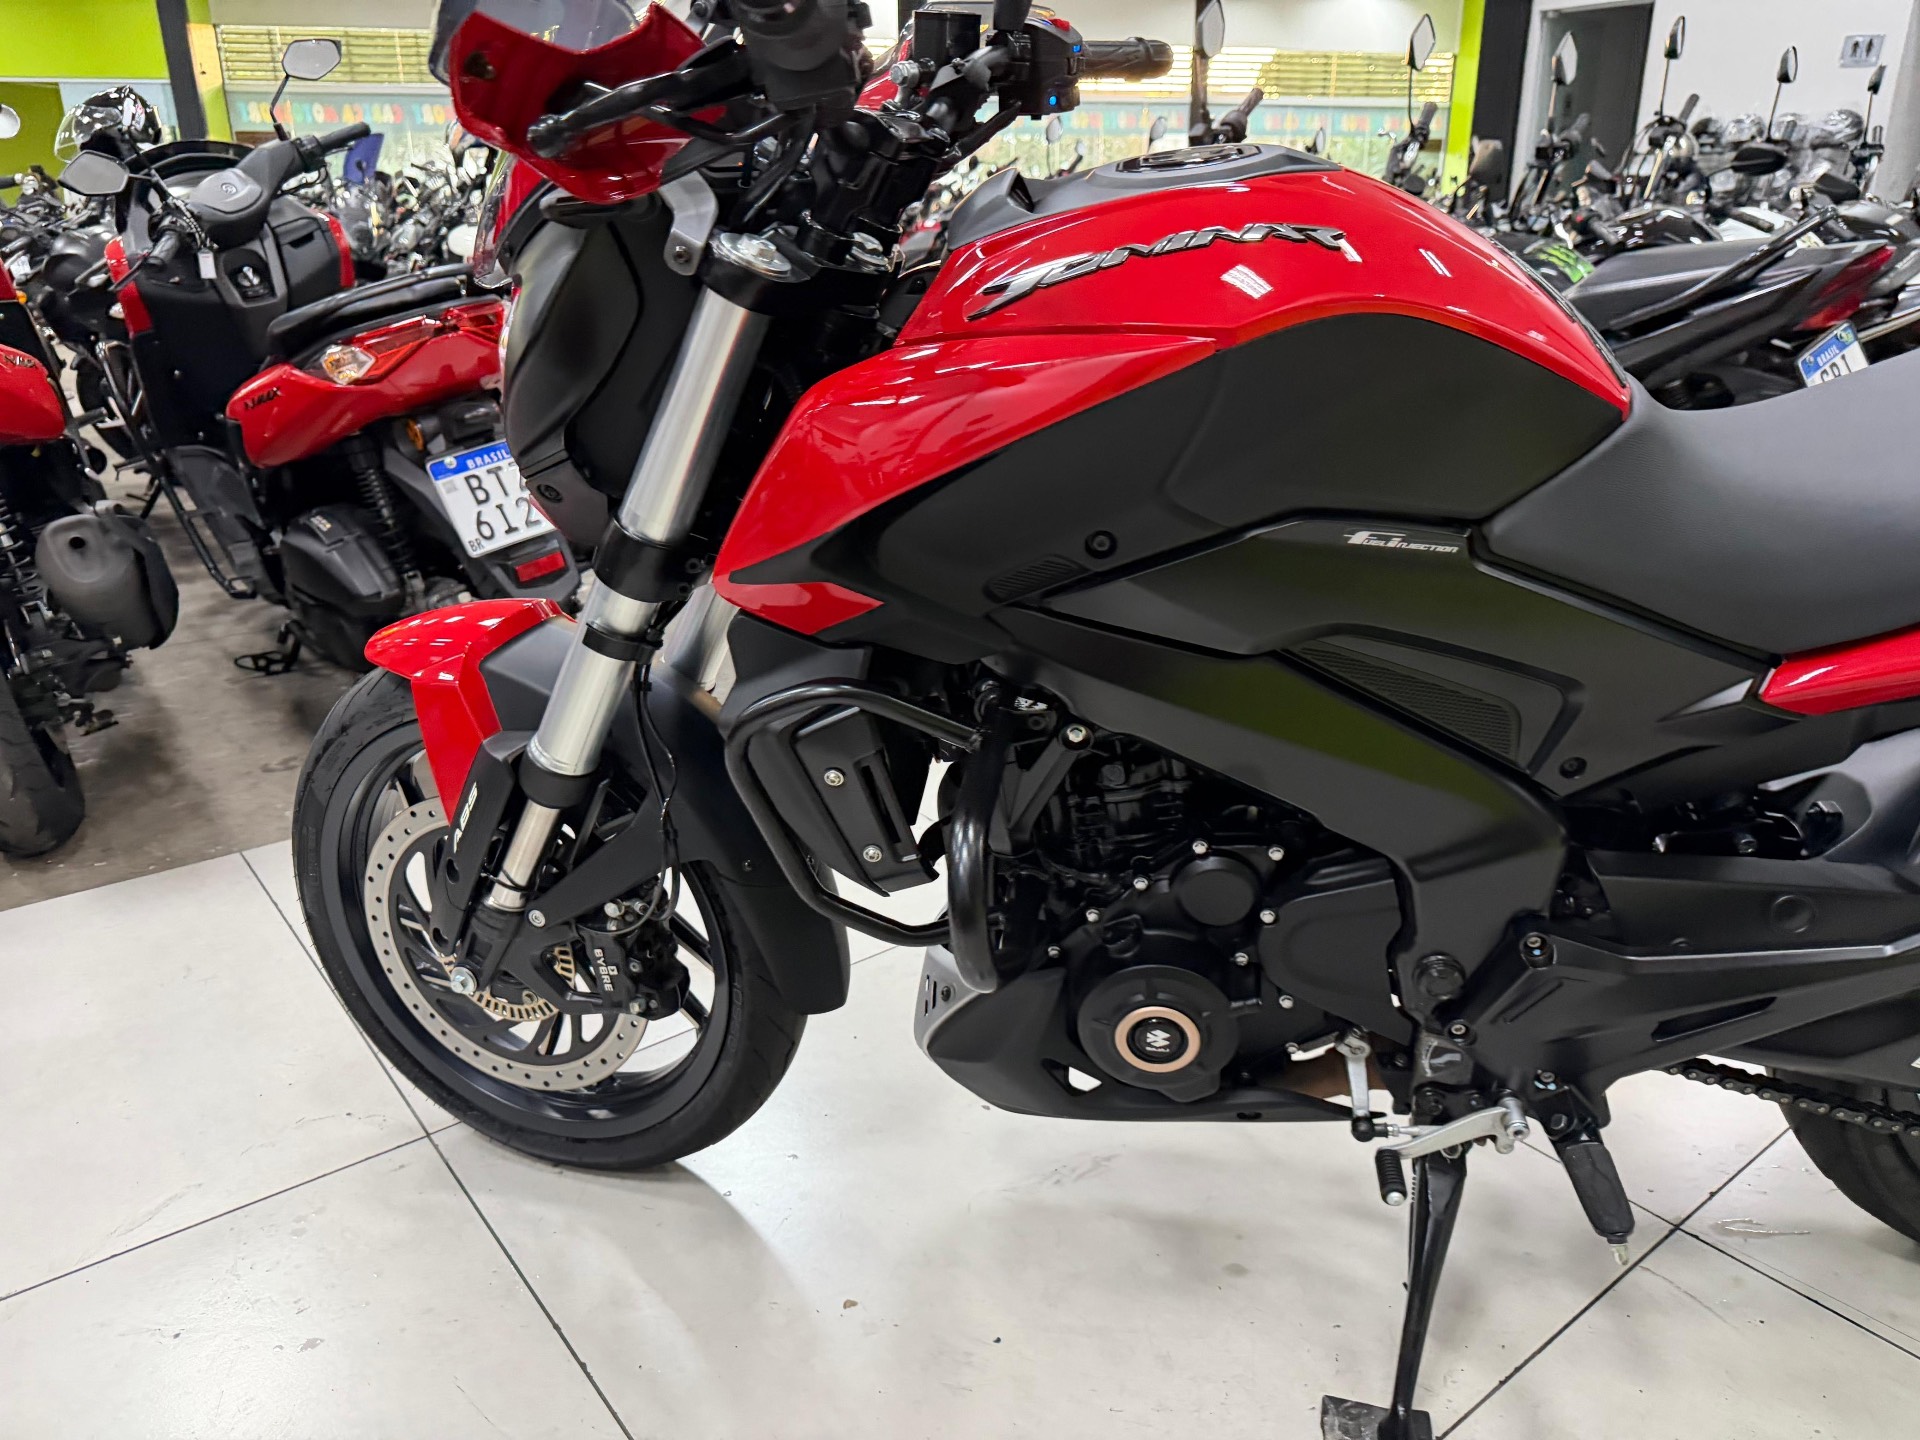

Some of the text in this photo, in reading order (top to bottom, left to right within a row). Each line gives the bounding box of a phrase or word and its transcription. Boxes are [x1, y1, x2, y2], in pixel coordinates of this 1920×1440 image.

[465, 448, 511, 470] BRASIL
[453, 781, 478, 854] ABS
[593, 948, 614, 992] BYBRE
